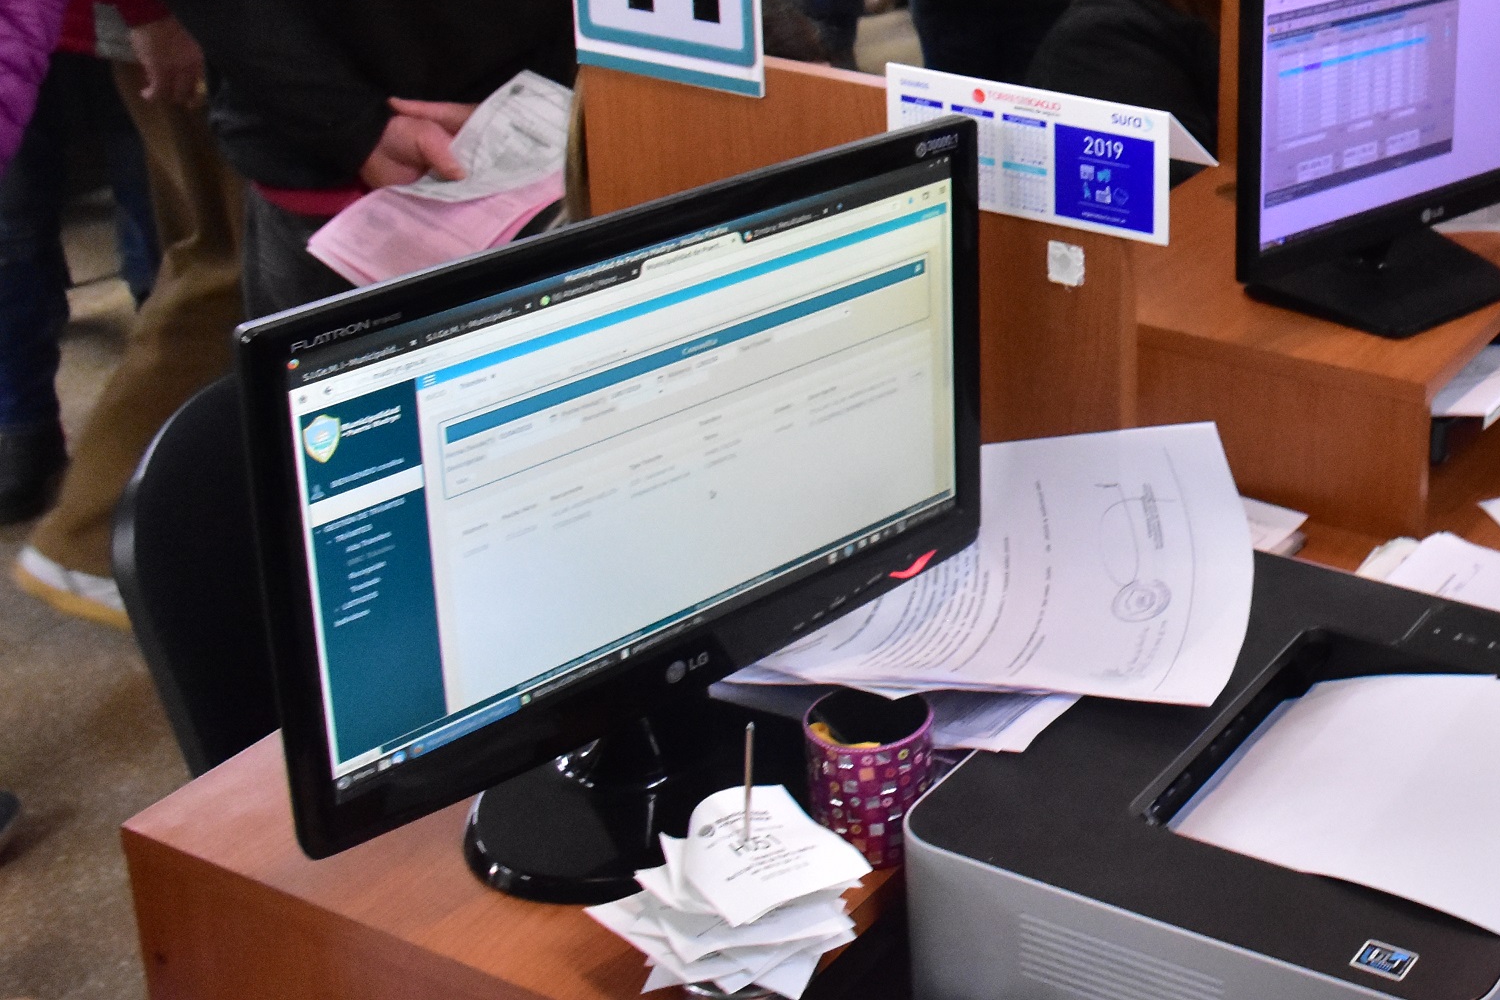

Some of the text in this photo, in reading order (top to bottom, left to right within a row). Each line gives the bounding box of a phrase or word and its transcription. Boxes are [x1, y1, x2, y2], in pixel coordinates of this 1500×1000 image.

[1111, 113, 1142, 128] sura
[1083, 135, 1124, 160] 2019
[291, 318, 370, 353] FLATRON
[689, 651, 709, 671] LG
